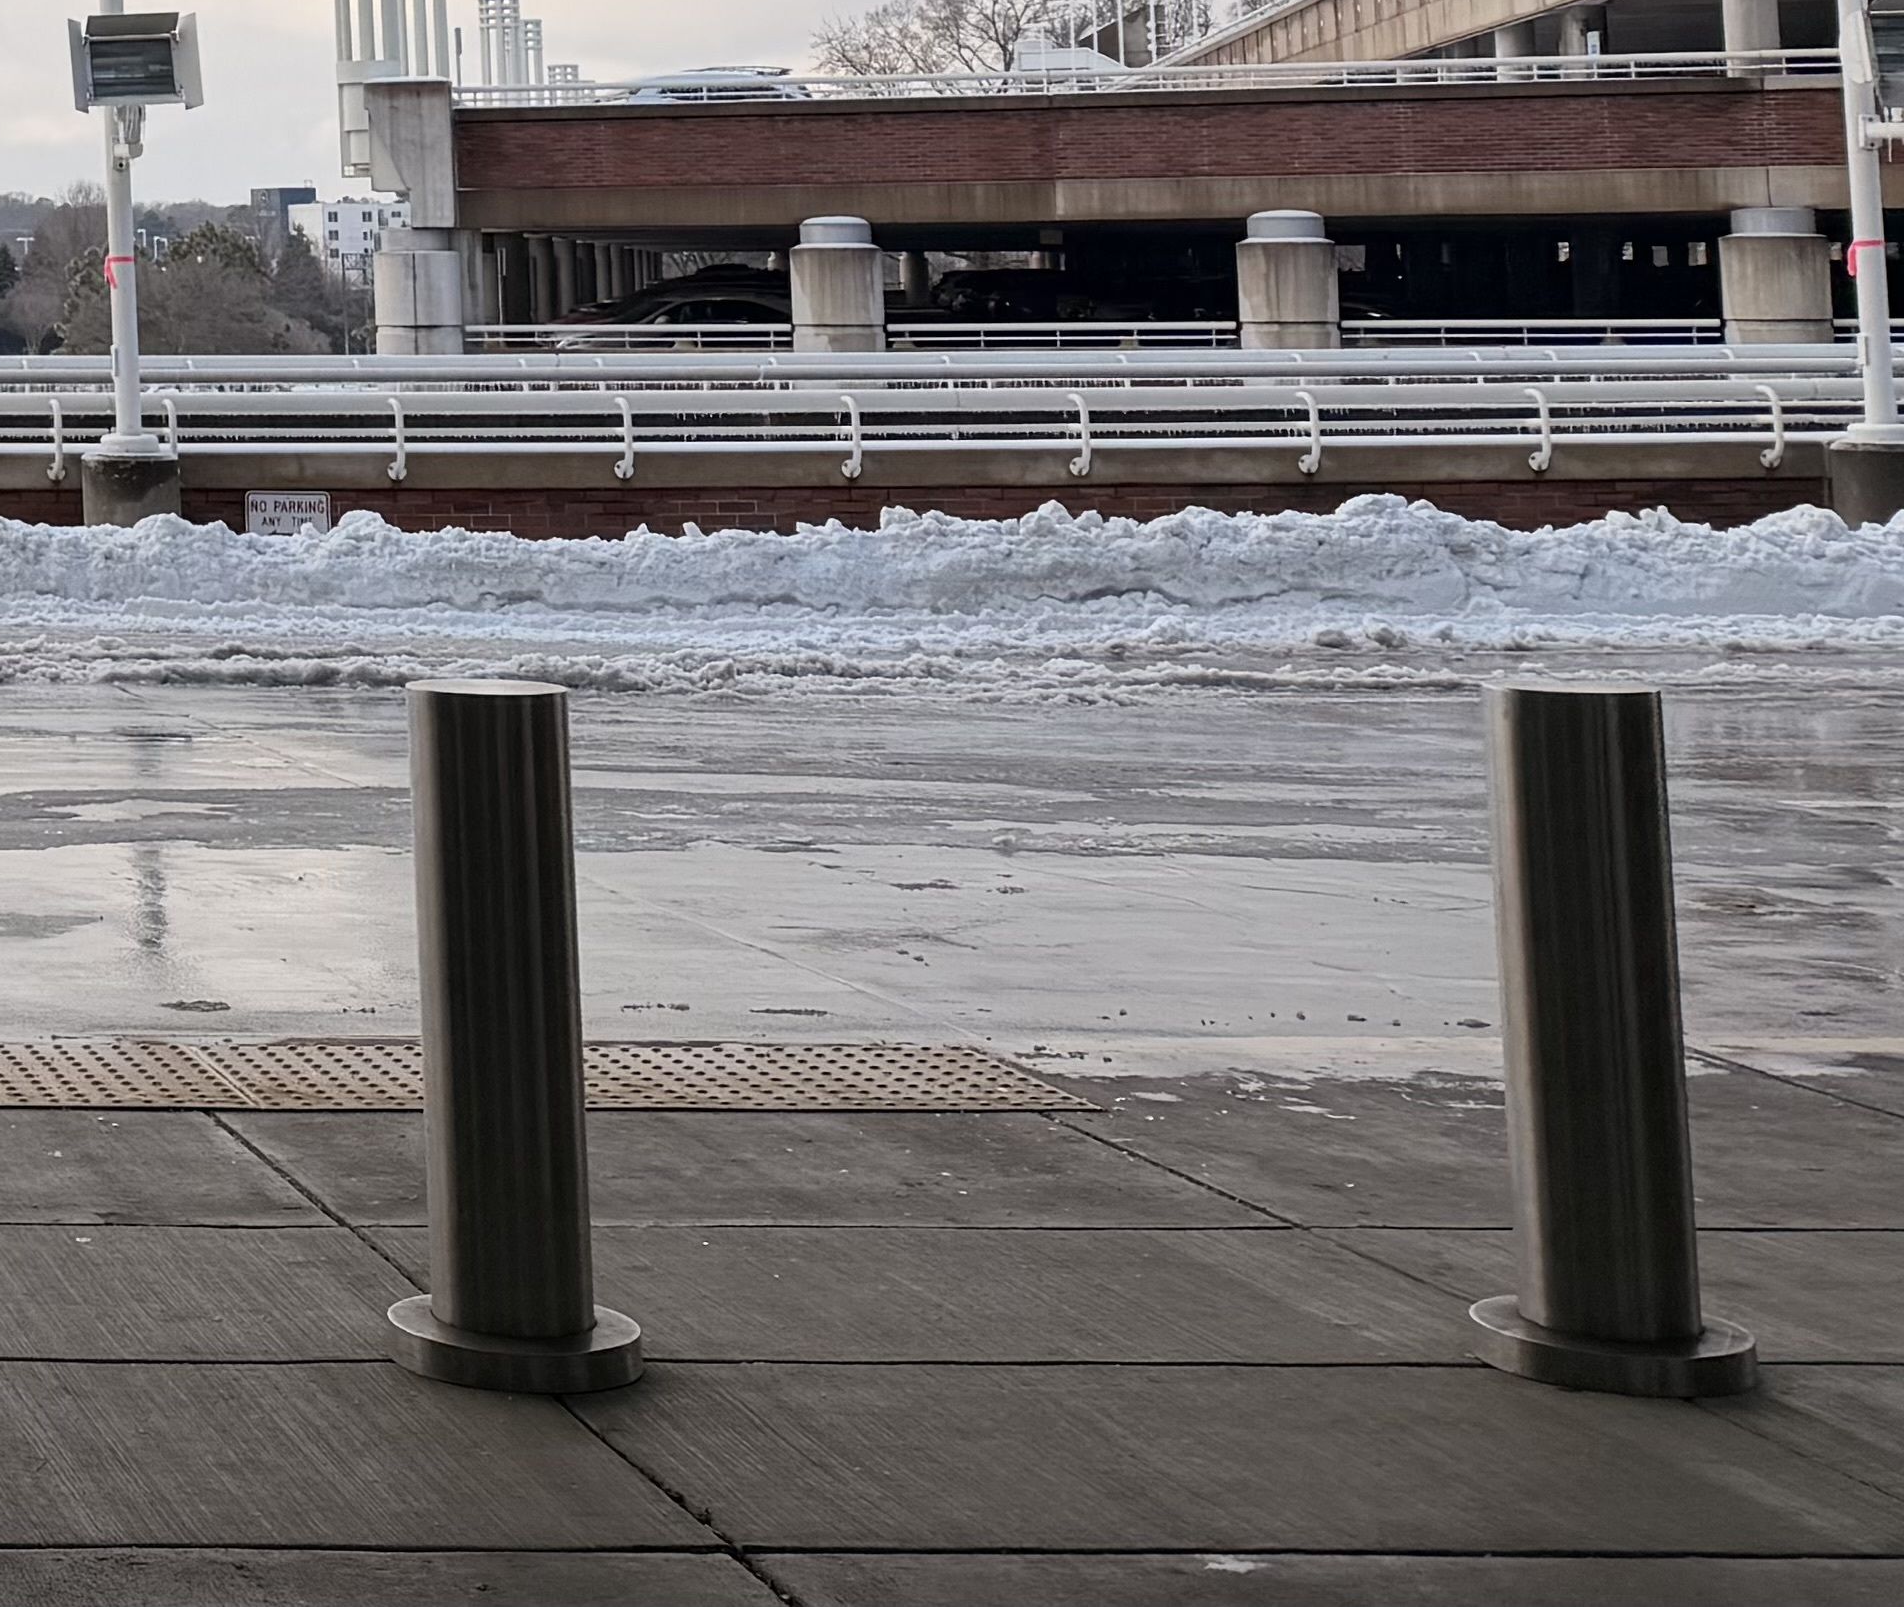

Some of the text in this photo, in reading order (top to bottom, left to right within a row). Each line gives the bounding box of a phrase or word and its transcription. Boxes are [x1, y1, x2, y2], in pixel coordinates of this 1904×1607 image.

[251, 499, 325, 514] NO PARKING
[261, 516, 281, 526] ANY
